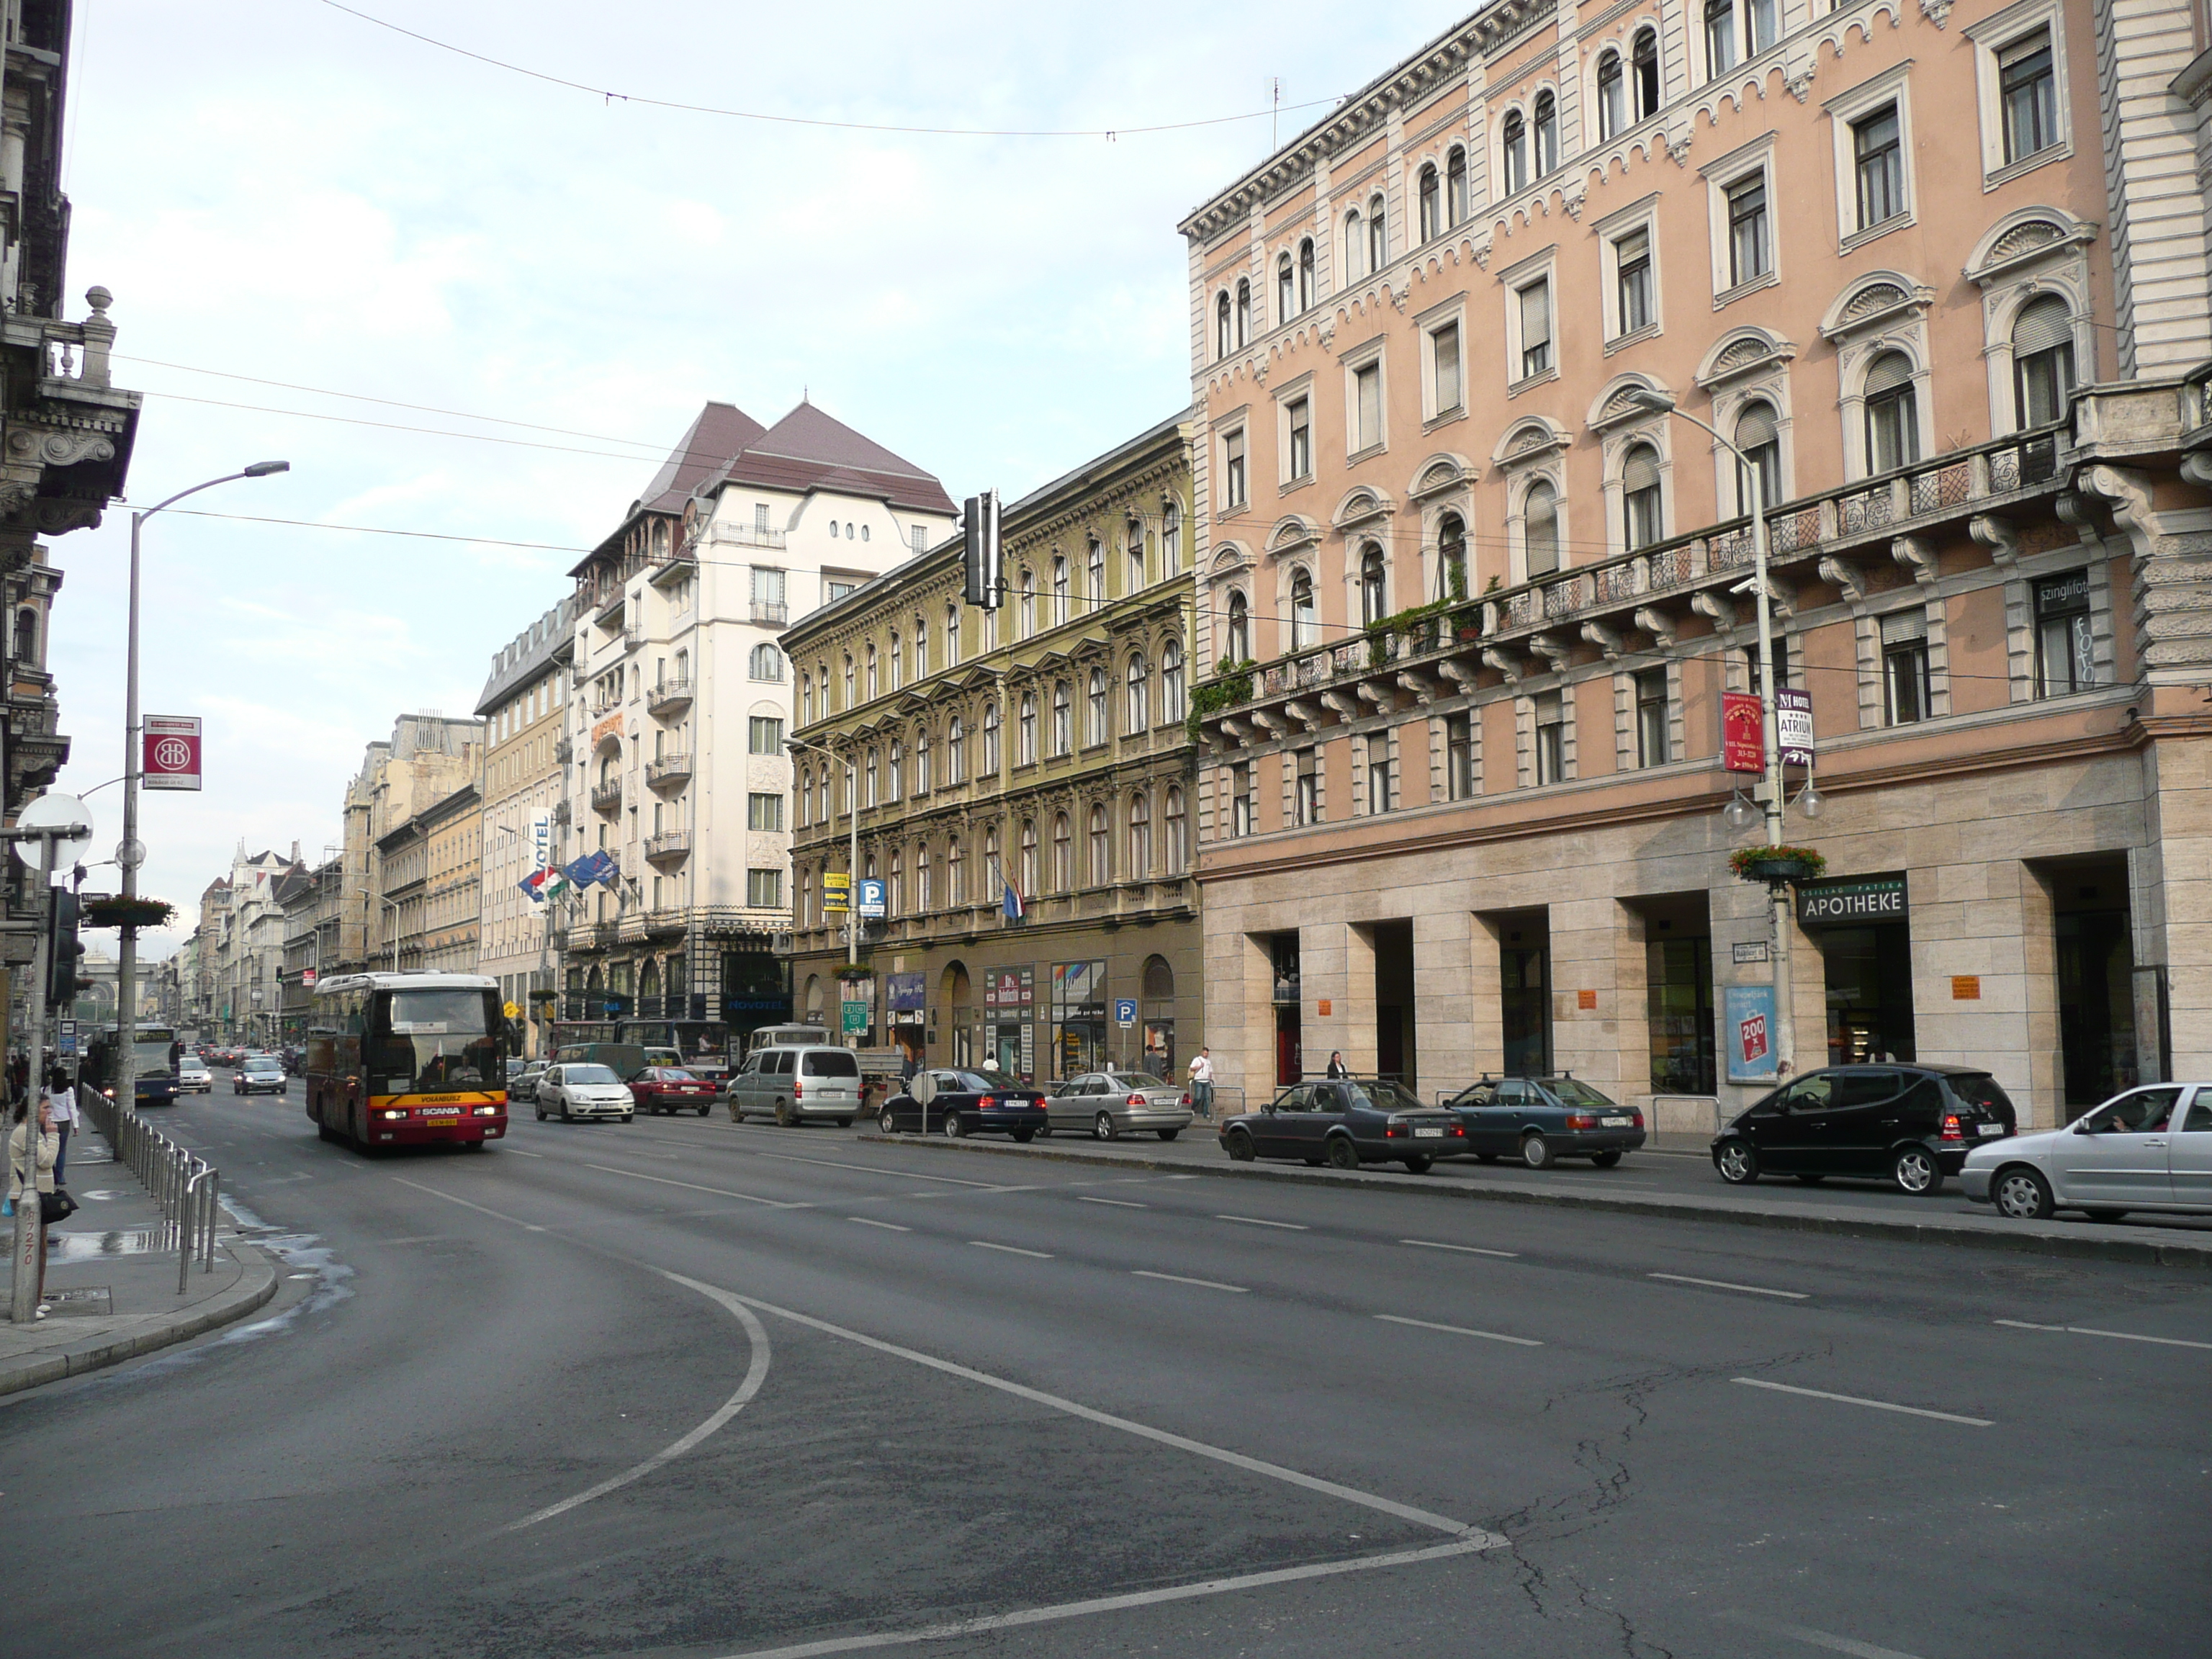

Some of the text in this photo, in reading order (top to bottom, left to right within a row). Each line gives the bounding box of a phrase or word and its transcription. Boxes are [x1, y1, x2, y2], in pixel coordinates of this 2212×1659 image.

[1793, 696, 1809, 709] HOTEL
[1781, 719, 1811, 734] ATRIUM
[865, 886, 880, 904] P
[1802, 882, 1903, 896] CSILLAG PATIKA
[1805, 892, 1901, 917] APOTHEKE
[728, 999, 786, 1010] NOVOTEL
[1120, 1006, 1131, 1020] P
[1743, 1020, 1764, 1040] 200
[422, 1107, 460, 1115] SCANIA
[24, 1211, 35, 1265] 87270
